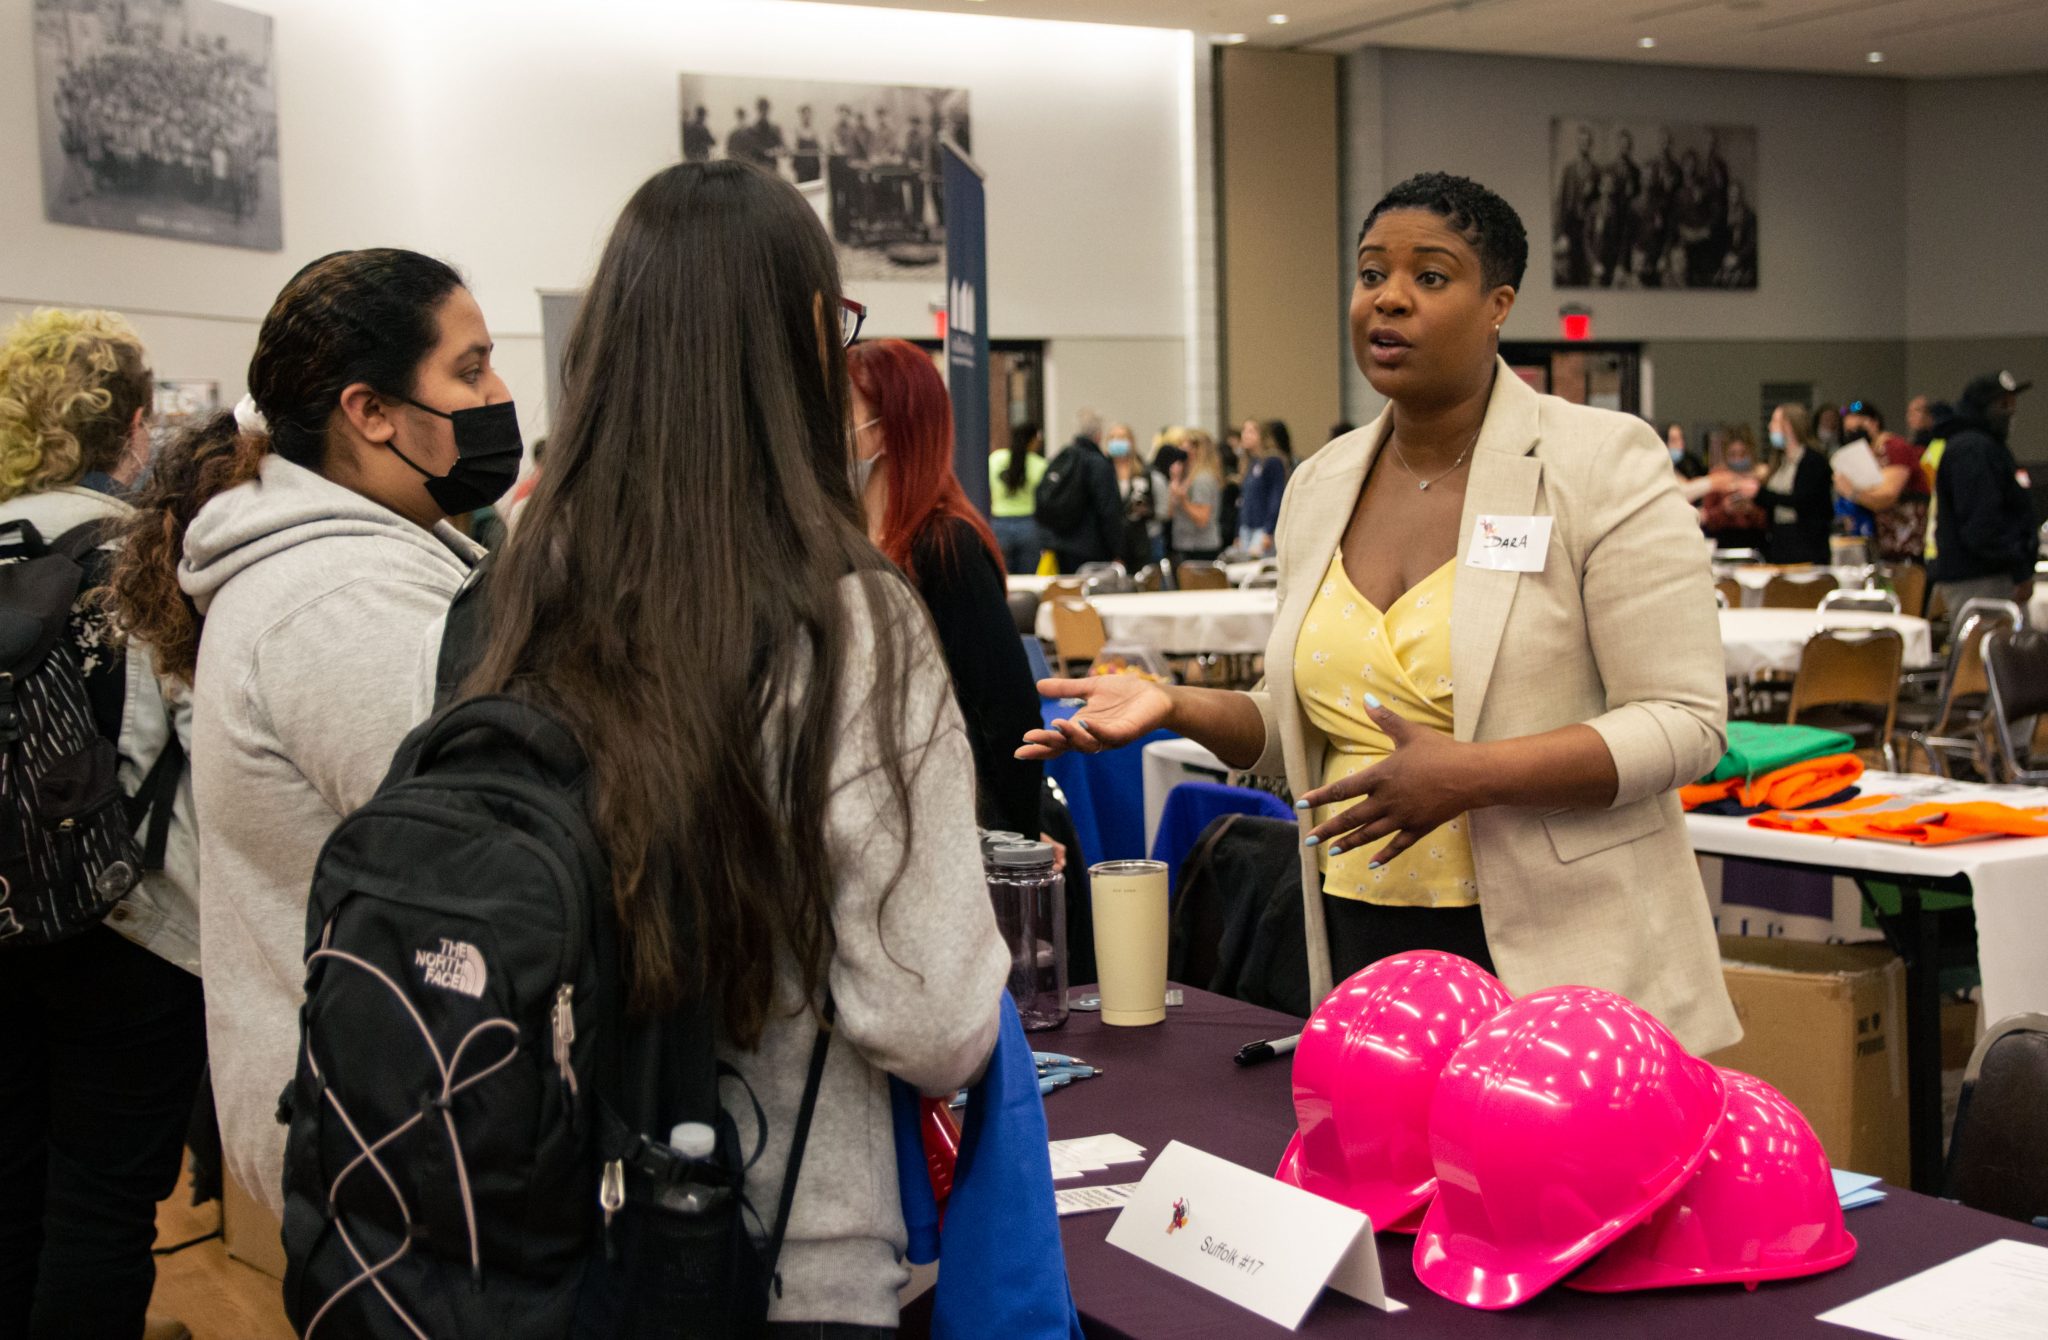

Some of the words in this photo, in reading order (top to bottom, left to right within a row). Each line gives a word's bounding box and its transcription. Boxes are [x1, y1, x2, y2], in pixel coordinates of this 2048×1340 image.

[1483, 534, 1528, 549] DARA
[440, 937, 467, 959] THE
[415, 949, 463, 975] NORTH
[424, 966, 461, 989] FACE
[1200, 1235, 1238, 1266] Suffolk
[1238, 1254, 1264, 1276] #17
